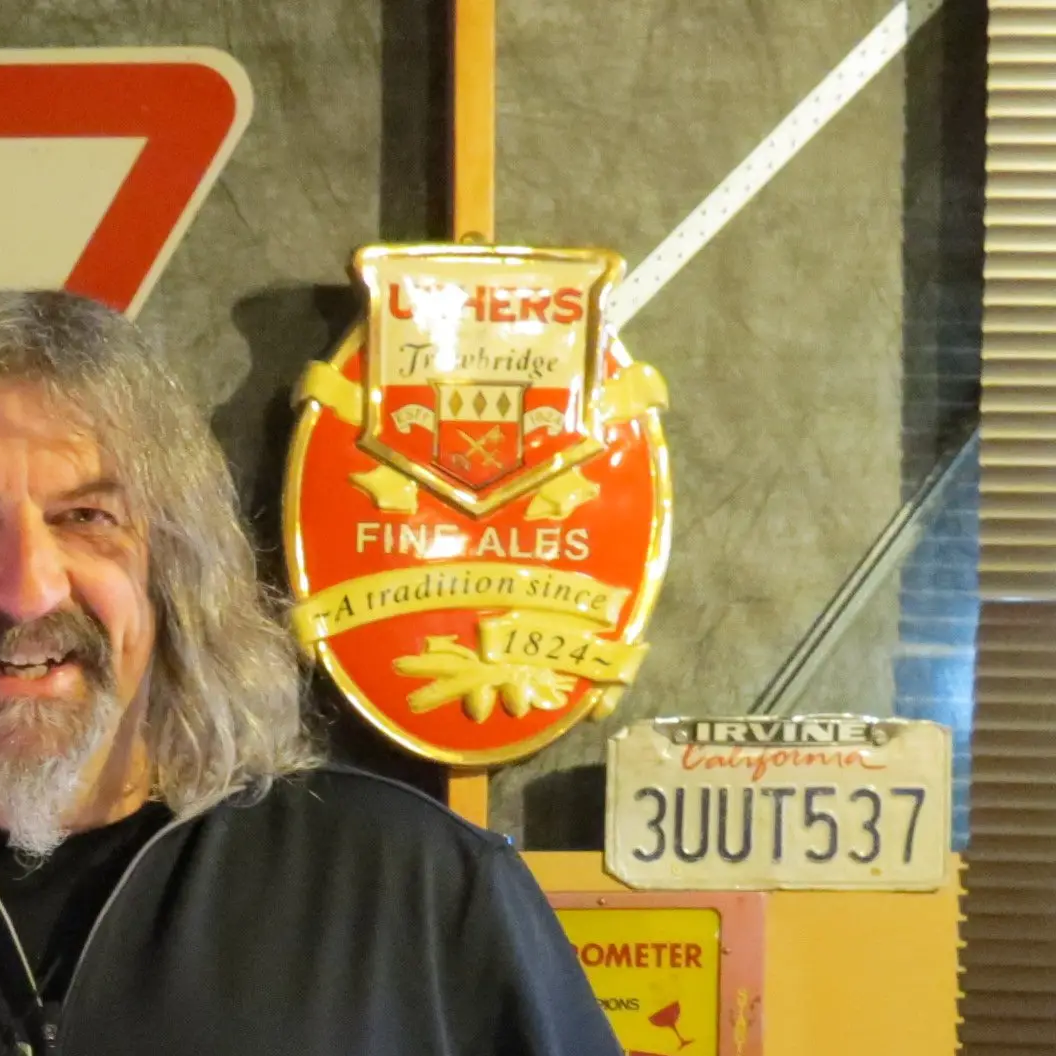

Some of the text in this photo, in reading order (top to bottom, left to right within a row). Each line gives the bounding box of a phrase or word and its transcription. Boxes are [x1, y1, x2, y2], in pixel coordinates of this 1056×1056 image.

[389, 283, 584, 323] UHERS
[399, 343, 558, 379] Trwbridge
[476, 526, 590, 560] ALES
[367, 570, 515, 611] tradition
[526, 574, 607, 611] since
[696, 722, 868, 742] IRVINE
[681, 744, 886, 782] California
[632, 786, 925, 864] 3UUT537
